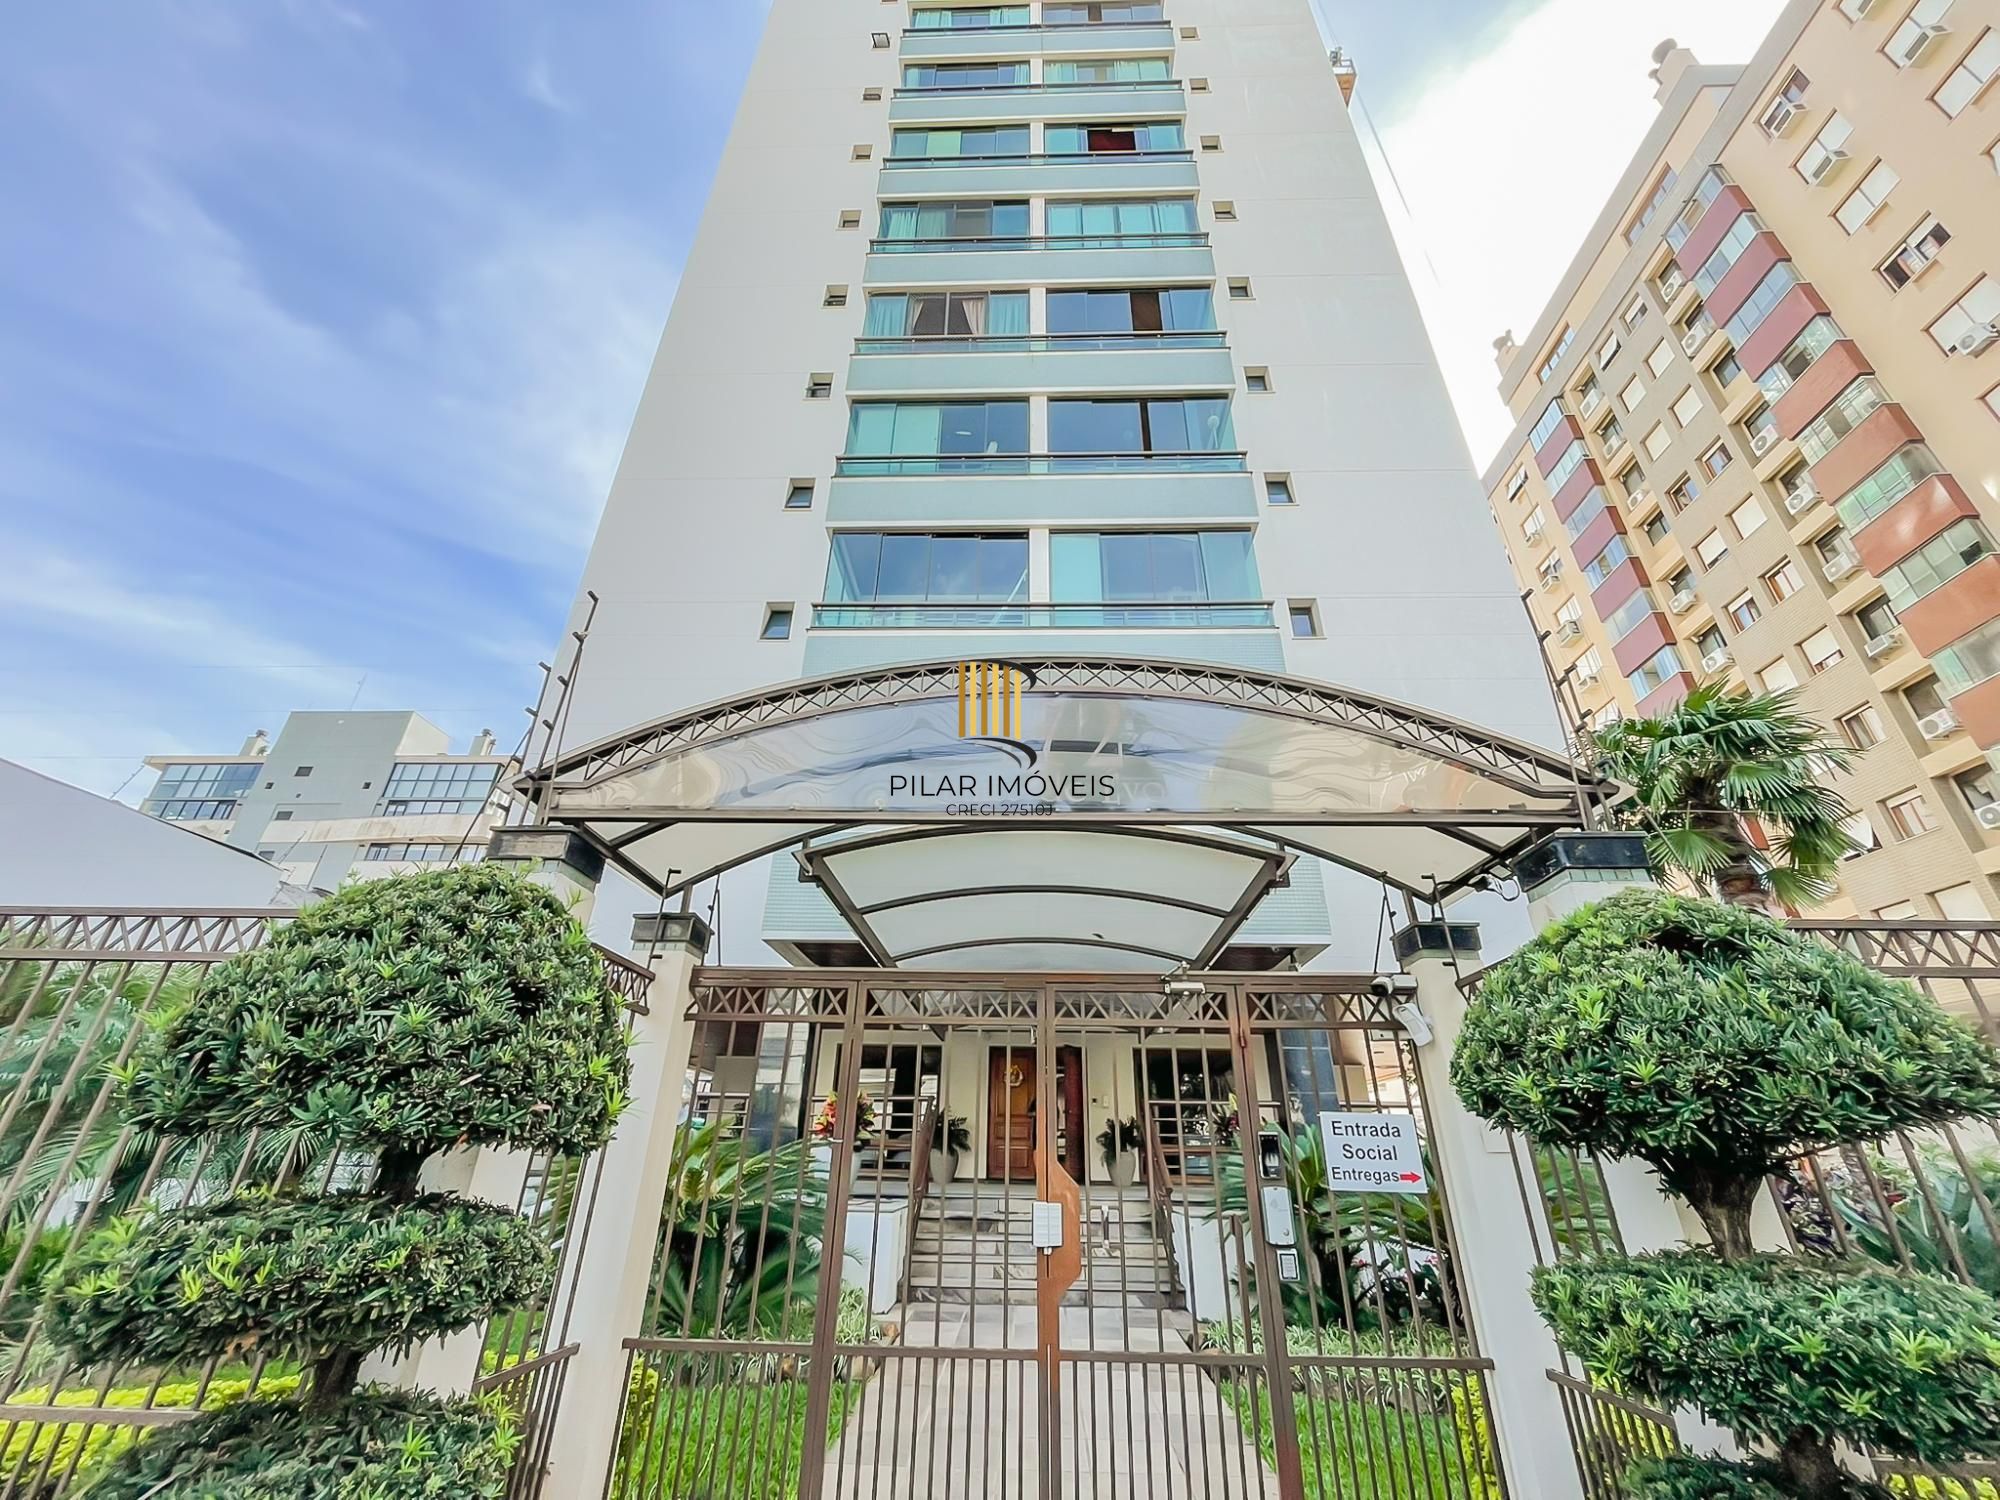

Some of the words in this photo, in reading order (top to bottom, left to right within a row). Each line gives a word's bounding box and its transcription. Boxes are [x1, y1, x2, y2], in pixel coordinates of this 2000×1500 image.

[1331, 1120, 1401, 1138] Entrada
[1342, 1144, 1398, 1161] Social
[1331, 1167, 1400, 1185] Entregas
